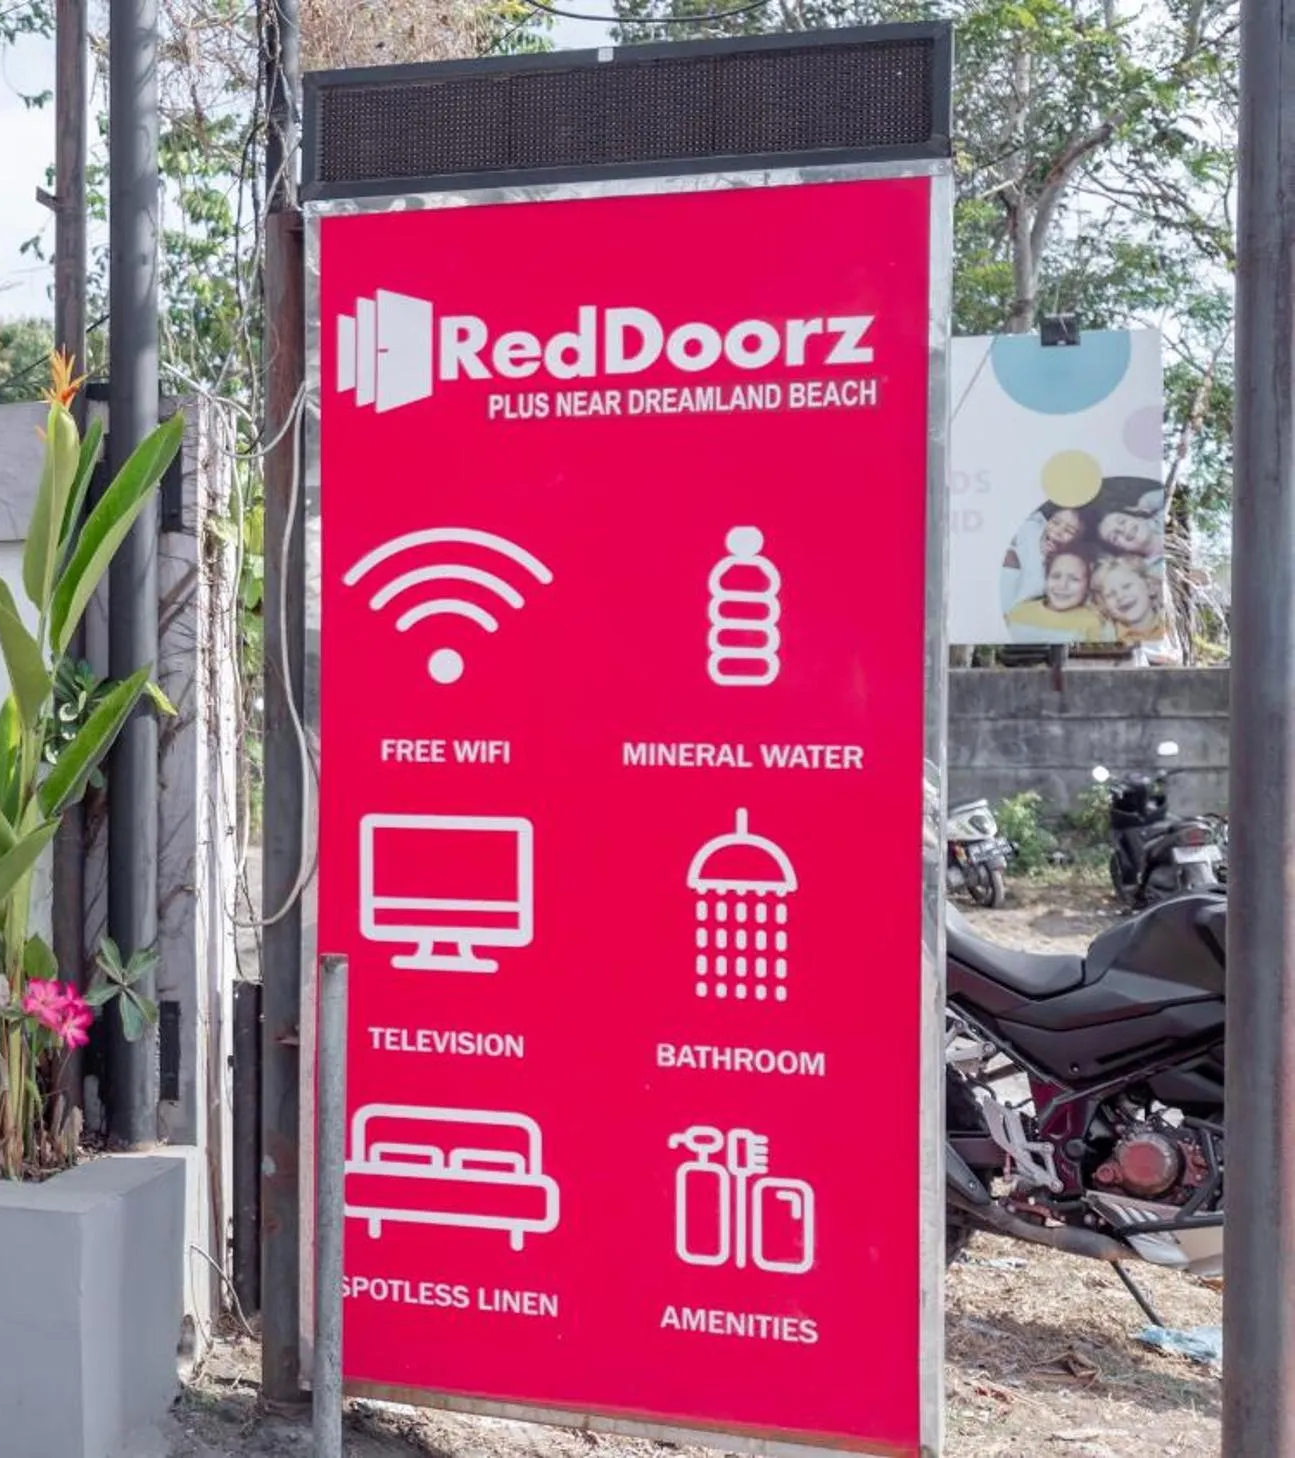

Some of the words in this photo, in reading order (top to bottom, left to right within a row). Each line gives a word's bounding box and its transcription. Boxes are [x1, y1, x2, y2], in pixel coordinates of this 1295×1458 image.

[439, 305, 875, 381] RedDoorz
[488, 392, 550, 420] PLUS
[555, 389, 622, 417] NEAR
[627, 383, 783, 415] DREAMLAND
[788, 379, 878, 409] BEACH
[381, 739, 446, 763] FREE
[453, 740, 511, 764] WIFI
[622, 742, 753, 768] MINERAL
[760, 744, 864, 769] WATER
[368, 1027, 525, 1058] TELEVISION
[656, 1043, 826, 1076] BATHROOM
[477, 1287, 559, 1317] LINEN
[660, 1305, 819, 1345] AMENITIES
